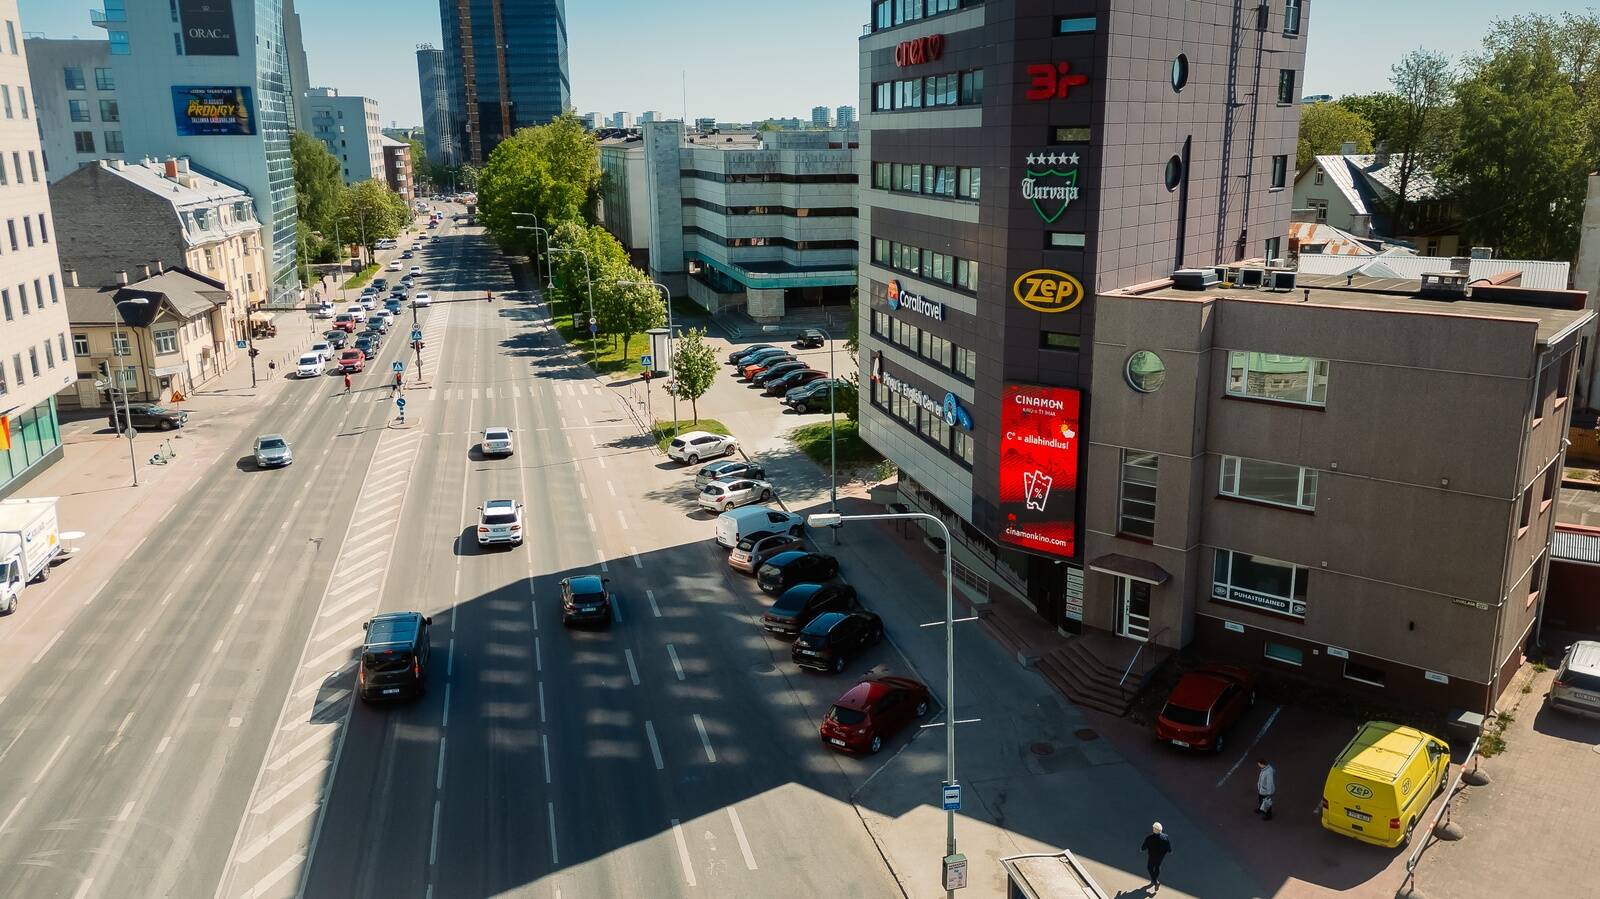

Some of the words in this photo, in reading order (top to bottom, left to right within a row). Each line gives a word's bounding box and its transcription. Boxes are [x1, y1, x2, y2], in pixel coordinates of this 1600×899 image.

[187, 104, 235, 116] PRODIGY
[1022, 178, 1079, 207] Turvaja
[900, 290, 942, 321] Coraltravel
[1015, 395, 1064, 410] CINAMON
[1024, 435, 1069, 450] allahindlus!
[1005, 527, 1067, 547] cinamonkino.com
[1233, 591, 1286, 608] PUHASTUSAINED
